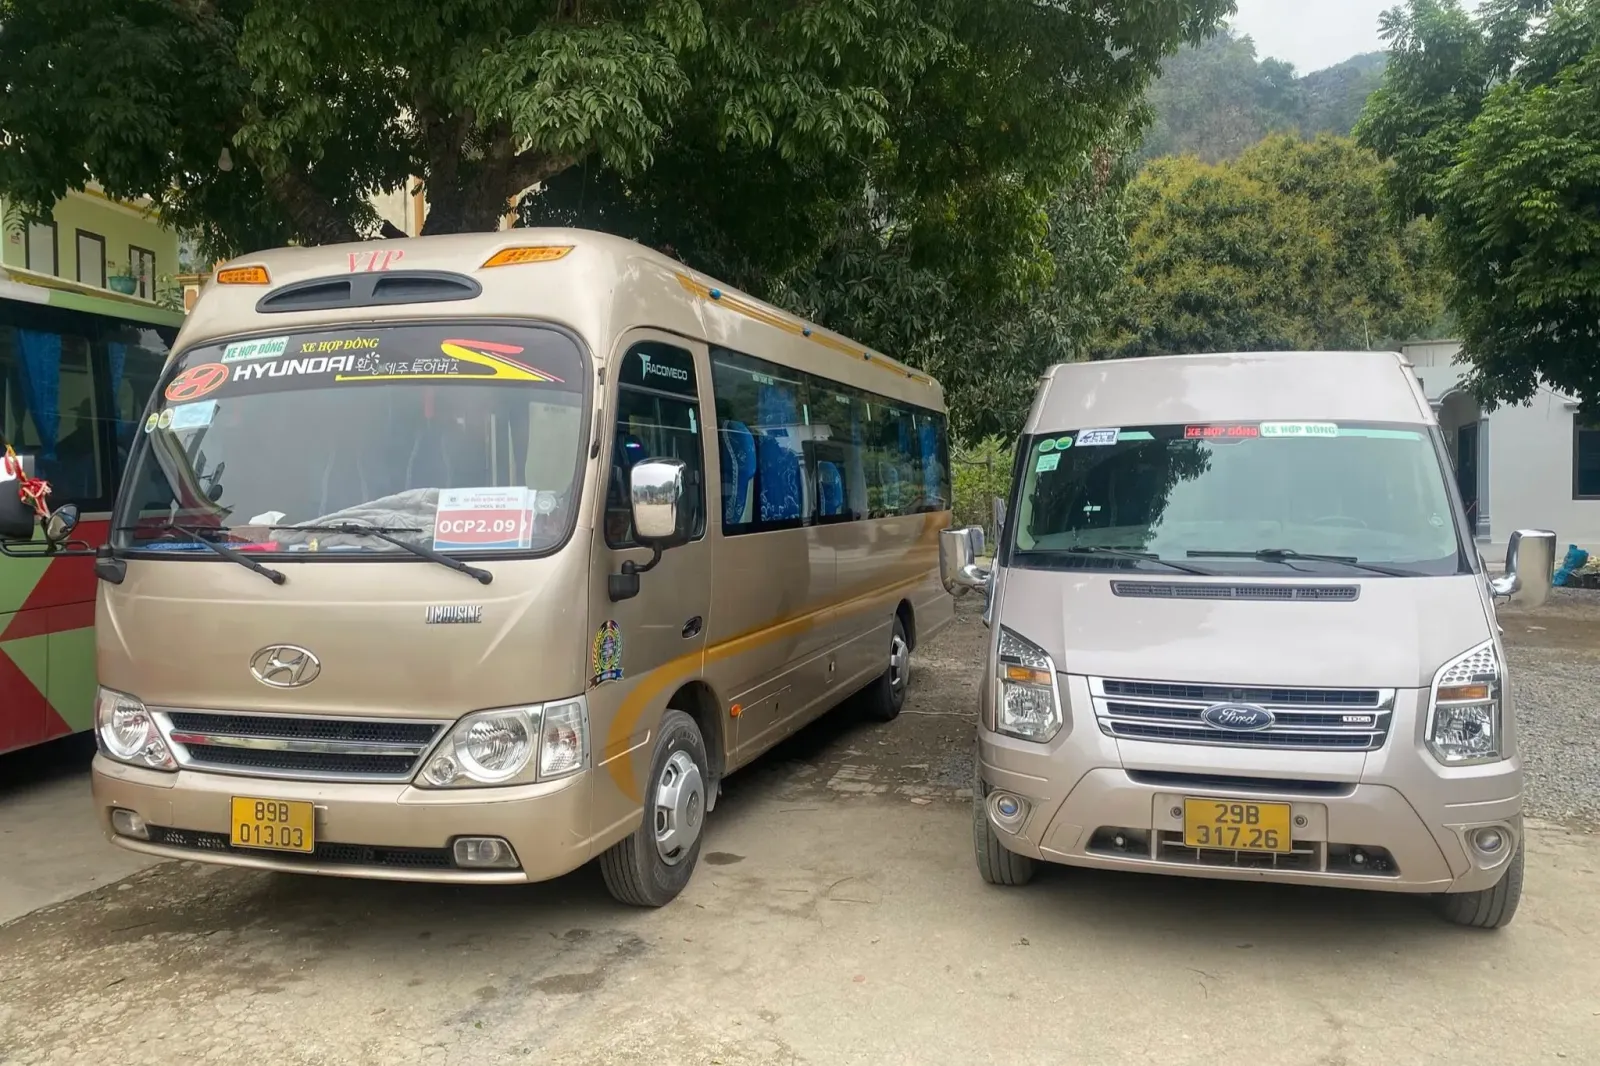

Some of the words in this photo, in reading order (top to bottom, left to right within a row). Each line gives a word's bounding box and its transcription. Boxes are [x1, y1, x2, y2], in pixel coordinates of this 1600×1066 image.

[347, 249, 405, 272] VIP
[225, 347, 238, 359] XE
[300, 343, 317, 353] XE
[318, 340, 343, 353] HỢP
[233, 355, 355, 382] HYUNDAI
[637, 353, 688, 381] TRACOMECO
[1187, 427, 1201, 436] XE
[1264, 425, 1278, 434] XE
[440, 519, 516, 533] OCP2.09
[425, 605, 482, 624] LIMOUSINE
[1218, 708, 1257, 725] Ford
[255, 801, 289, 822] 89B
[1214, 803, 1260, 825] 29B
[240, 823, 303, 848] 013.03
[1196, 825, 1279, 849] 317.26
